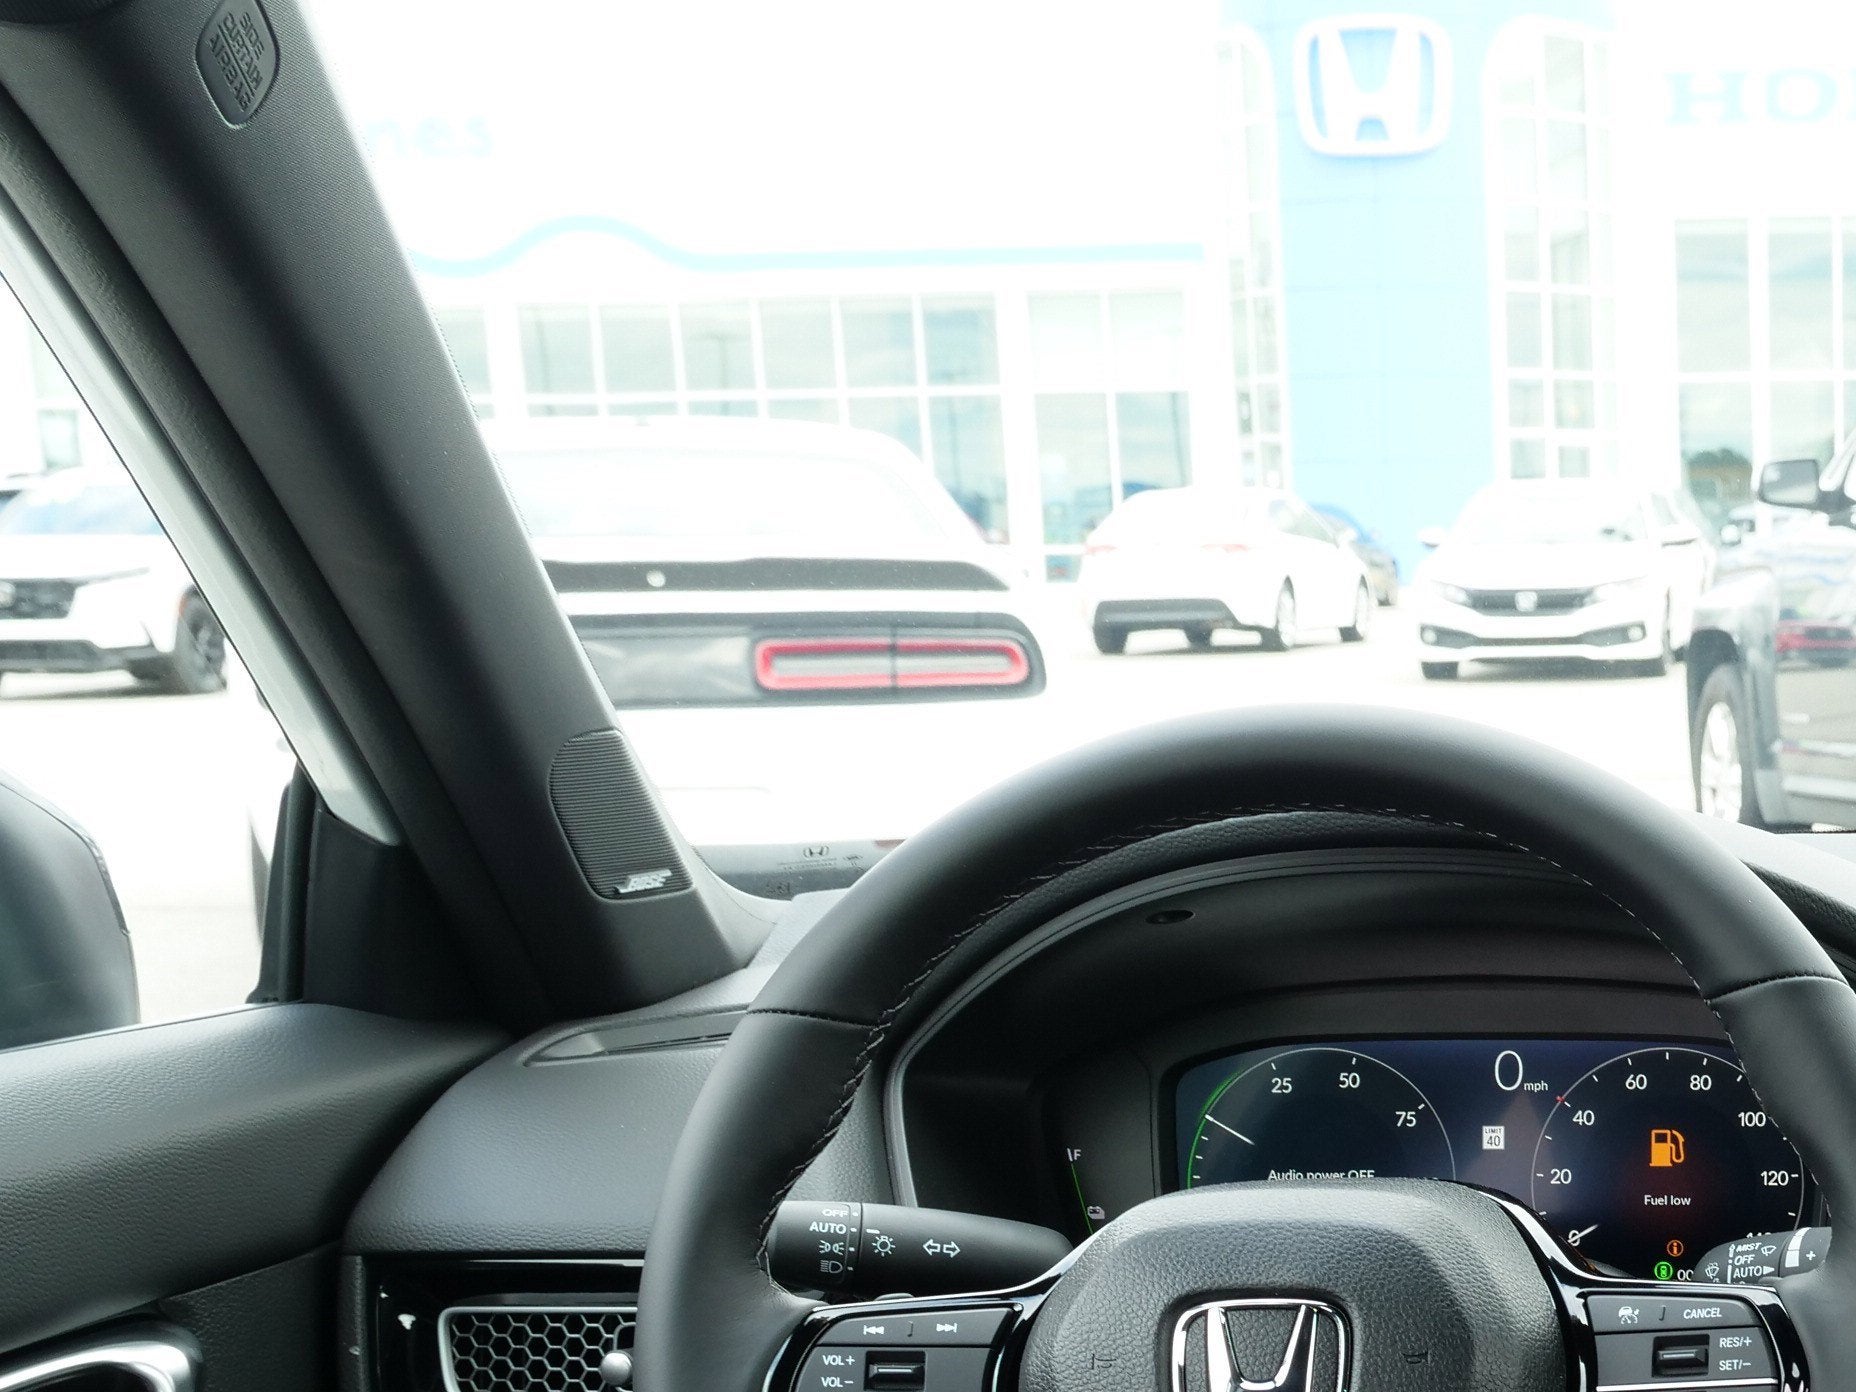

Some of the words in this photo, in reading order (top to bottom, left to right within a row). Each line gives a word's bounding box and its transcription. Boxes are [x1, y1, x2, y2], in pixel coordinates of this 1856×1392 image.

[210, 33, 251, 112] AIRBAG
[1494, 1050, 1523, 1091] 0
[1523, 1081, 1549, 1093] mph
[1271, 1077, 1293, 1093] 25
[1338, 1072, 1361, 1089] 50
[1625, 1074, 1647, 1090] 60
[1689, 1074, 1712, 1091] 80
[1395, 1111, 1417, 1127] 75
[1572, 1110, 1595, 1126] 40
[1738, 1111, 1767, 1127] 100
[1486, 1135, 1501, 1147] 40
[1073, 1149, 1081, 1160] F
[1268, 1169, 1304, 1180] Audio
[1550, 1168, 1572, 1185] 20
[1760, 1170, 1789, 1186] 120
[1643, 1194, 1669, 1206] Fuel
[1670, 1194, 1691, 1206] low
[821, 1208, 848, 1218] OFF
[809, 1221, 847, 1235] AUTO
[1736, 1242, 1762, 1253] MIST
[1734, 1254, 1755, 1266] OFF
[1733, 1265, 1763, 1279] AUTO
[1683, 1307, 1722, 1319] CANCEL
[1719, 1336, 1752, 1348] RES/+
[822, 1354, 855, 1366] VOL+
